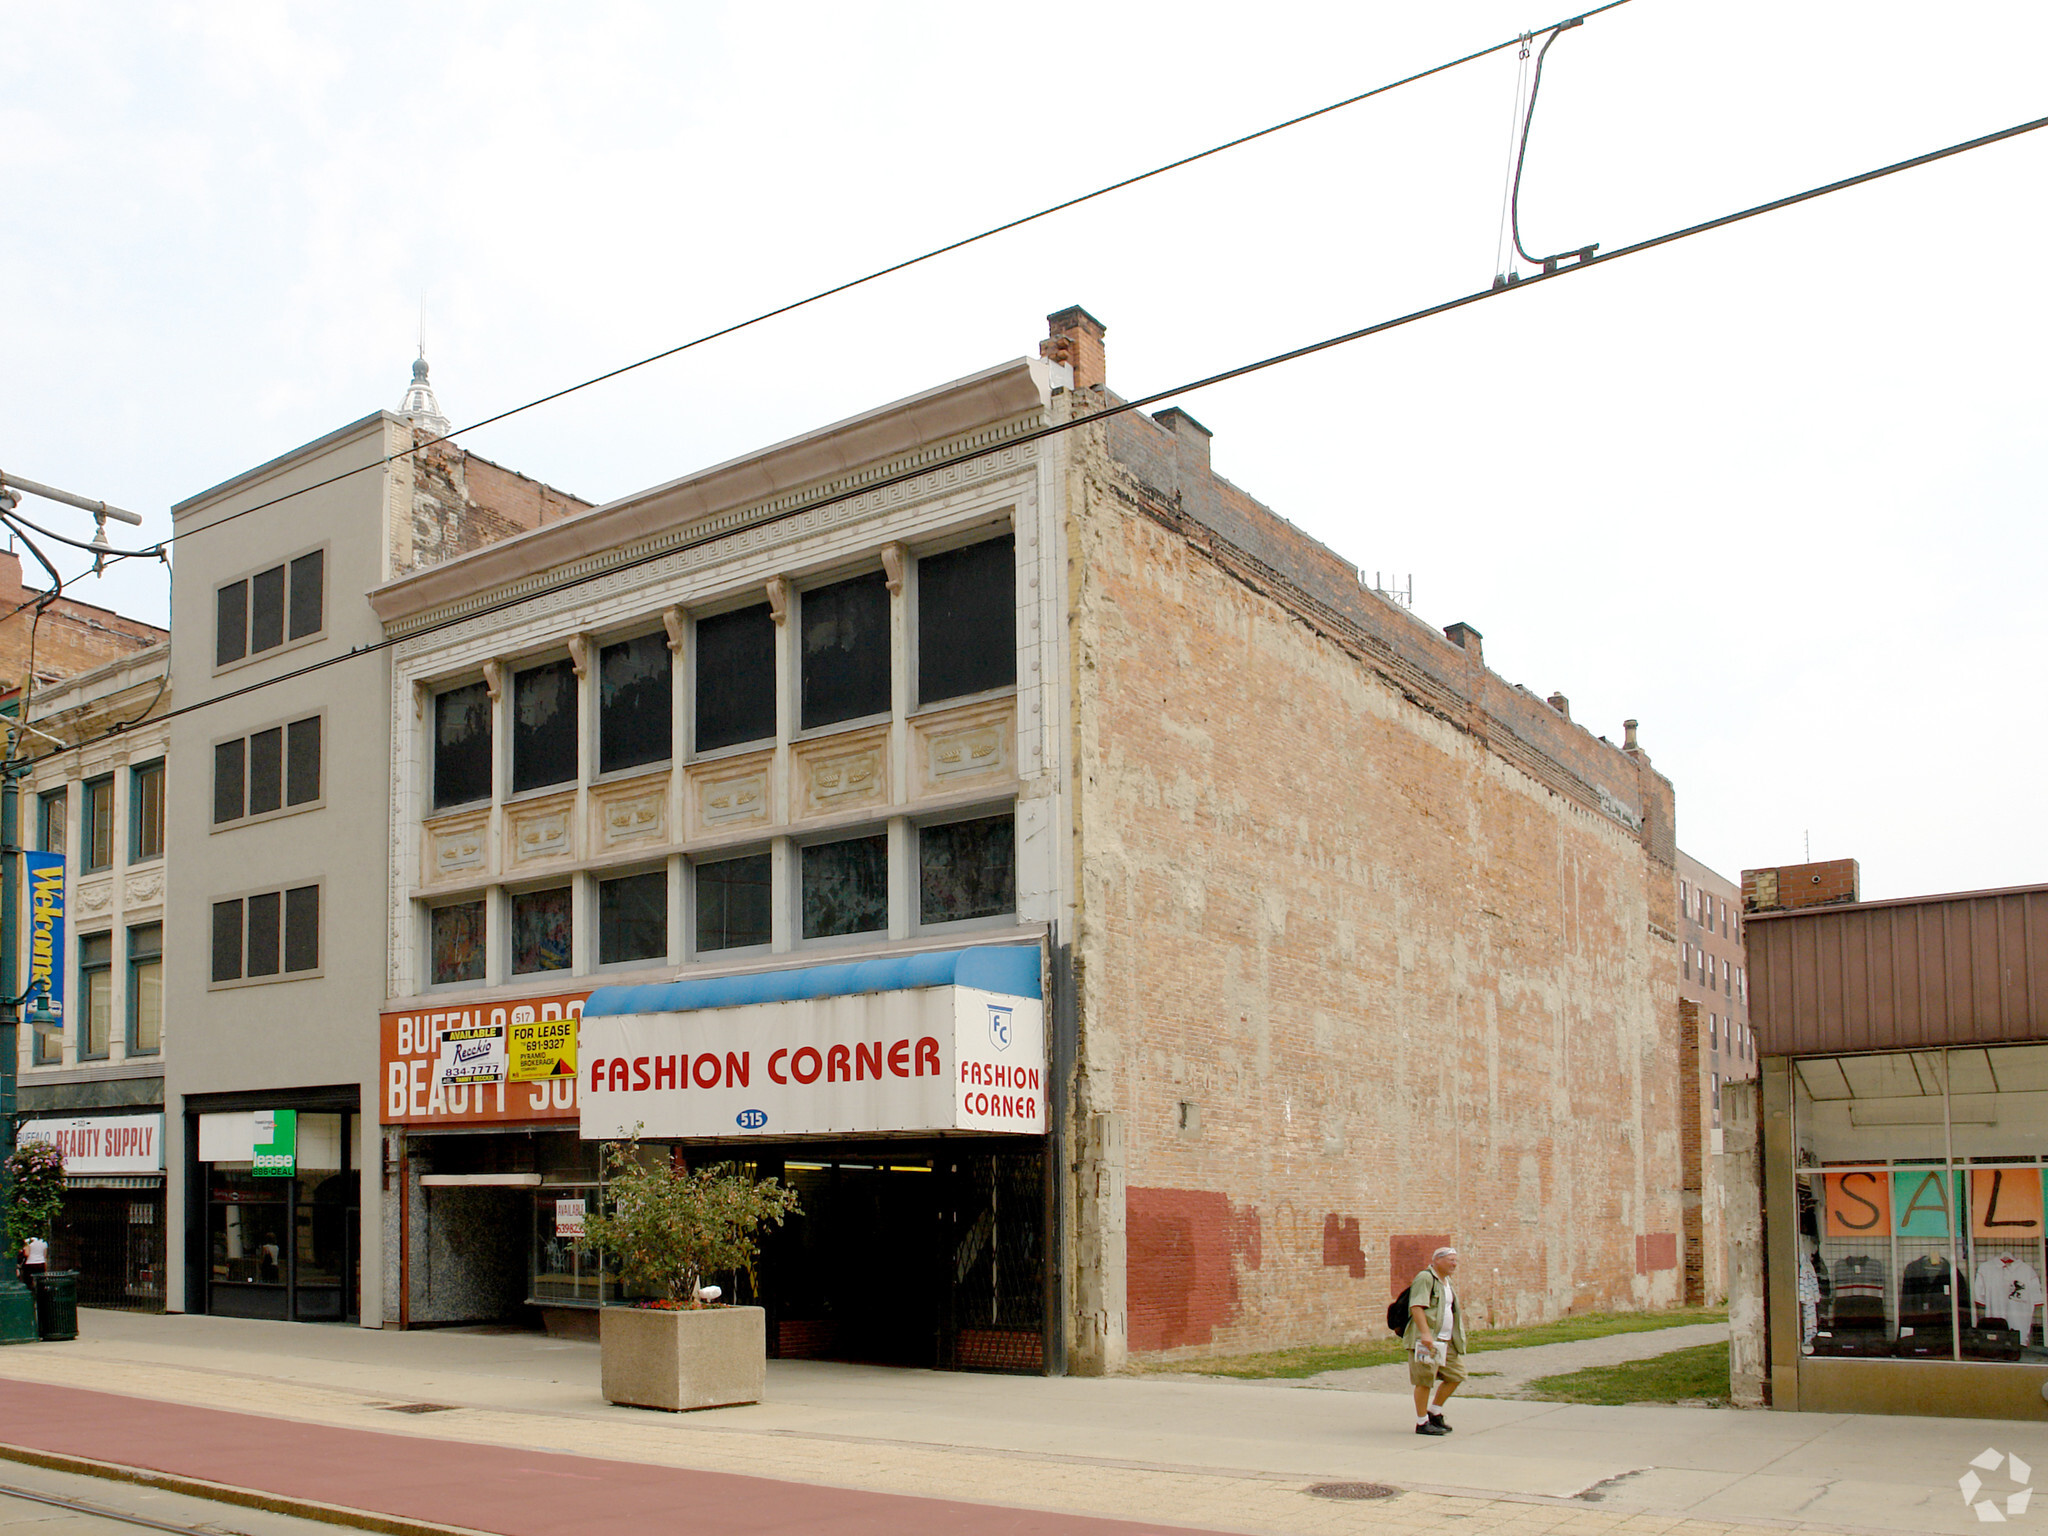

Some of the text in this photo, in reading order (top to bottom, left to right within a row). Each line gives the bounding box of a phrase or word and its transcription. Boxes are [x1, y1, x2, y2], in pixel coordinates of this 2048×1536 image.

[32, 865, 64, 990] Welcome
[515, 1011, 530, 1023] 517
[450, 1027, 497, 1041] AVAILABLE
[514, 1024, 571, 1040] FOR LEASE
[526, 1038, 565, 1051] 691-9327
[520, 1052, 547, 1060] PYRAMID
[520, 1058, 555, 1067] BROKERAGE
[445, 1064, 499, 1077] 834-7777
[591, 1036, 941, 1092] FASHION CORNER
[961, 1060, 1039, 1090] FASHION
[964, 1092, 1036, 1120] CORNER
[740, 1112, 763, 1126] 515
[56, 1127, 153, 1158] BEAUTY SUPPLY
[253, 1151, 293, 1168] lease
